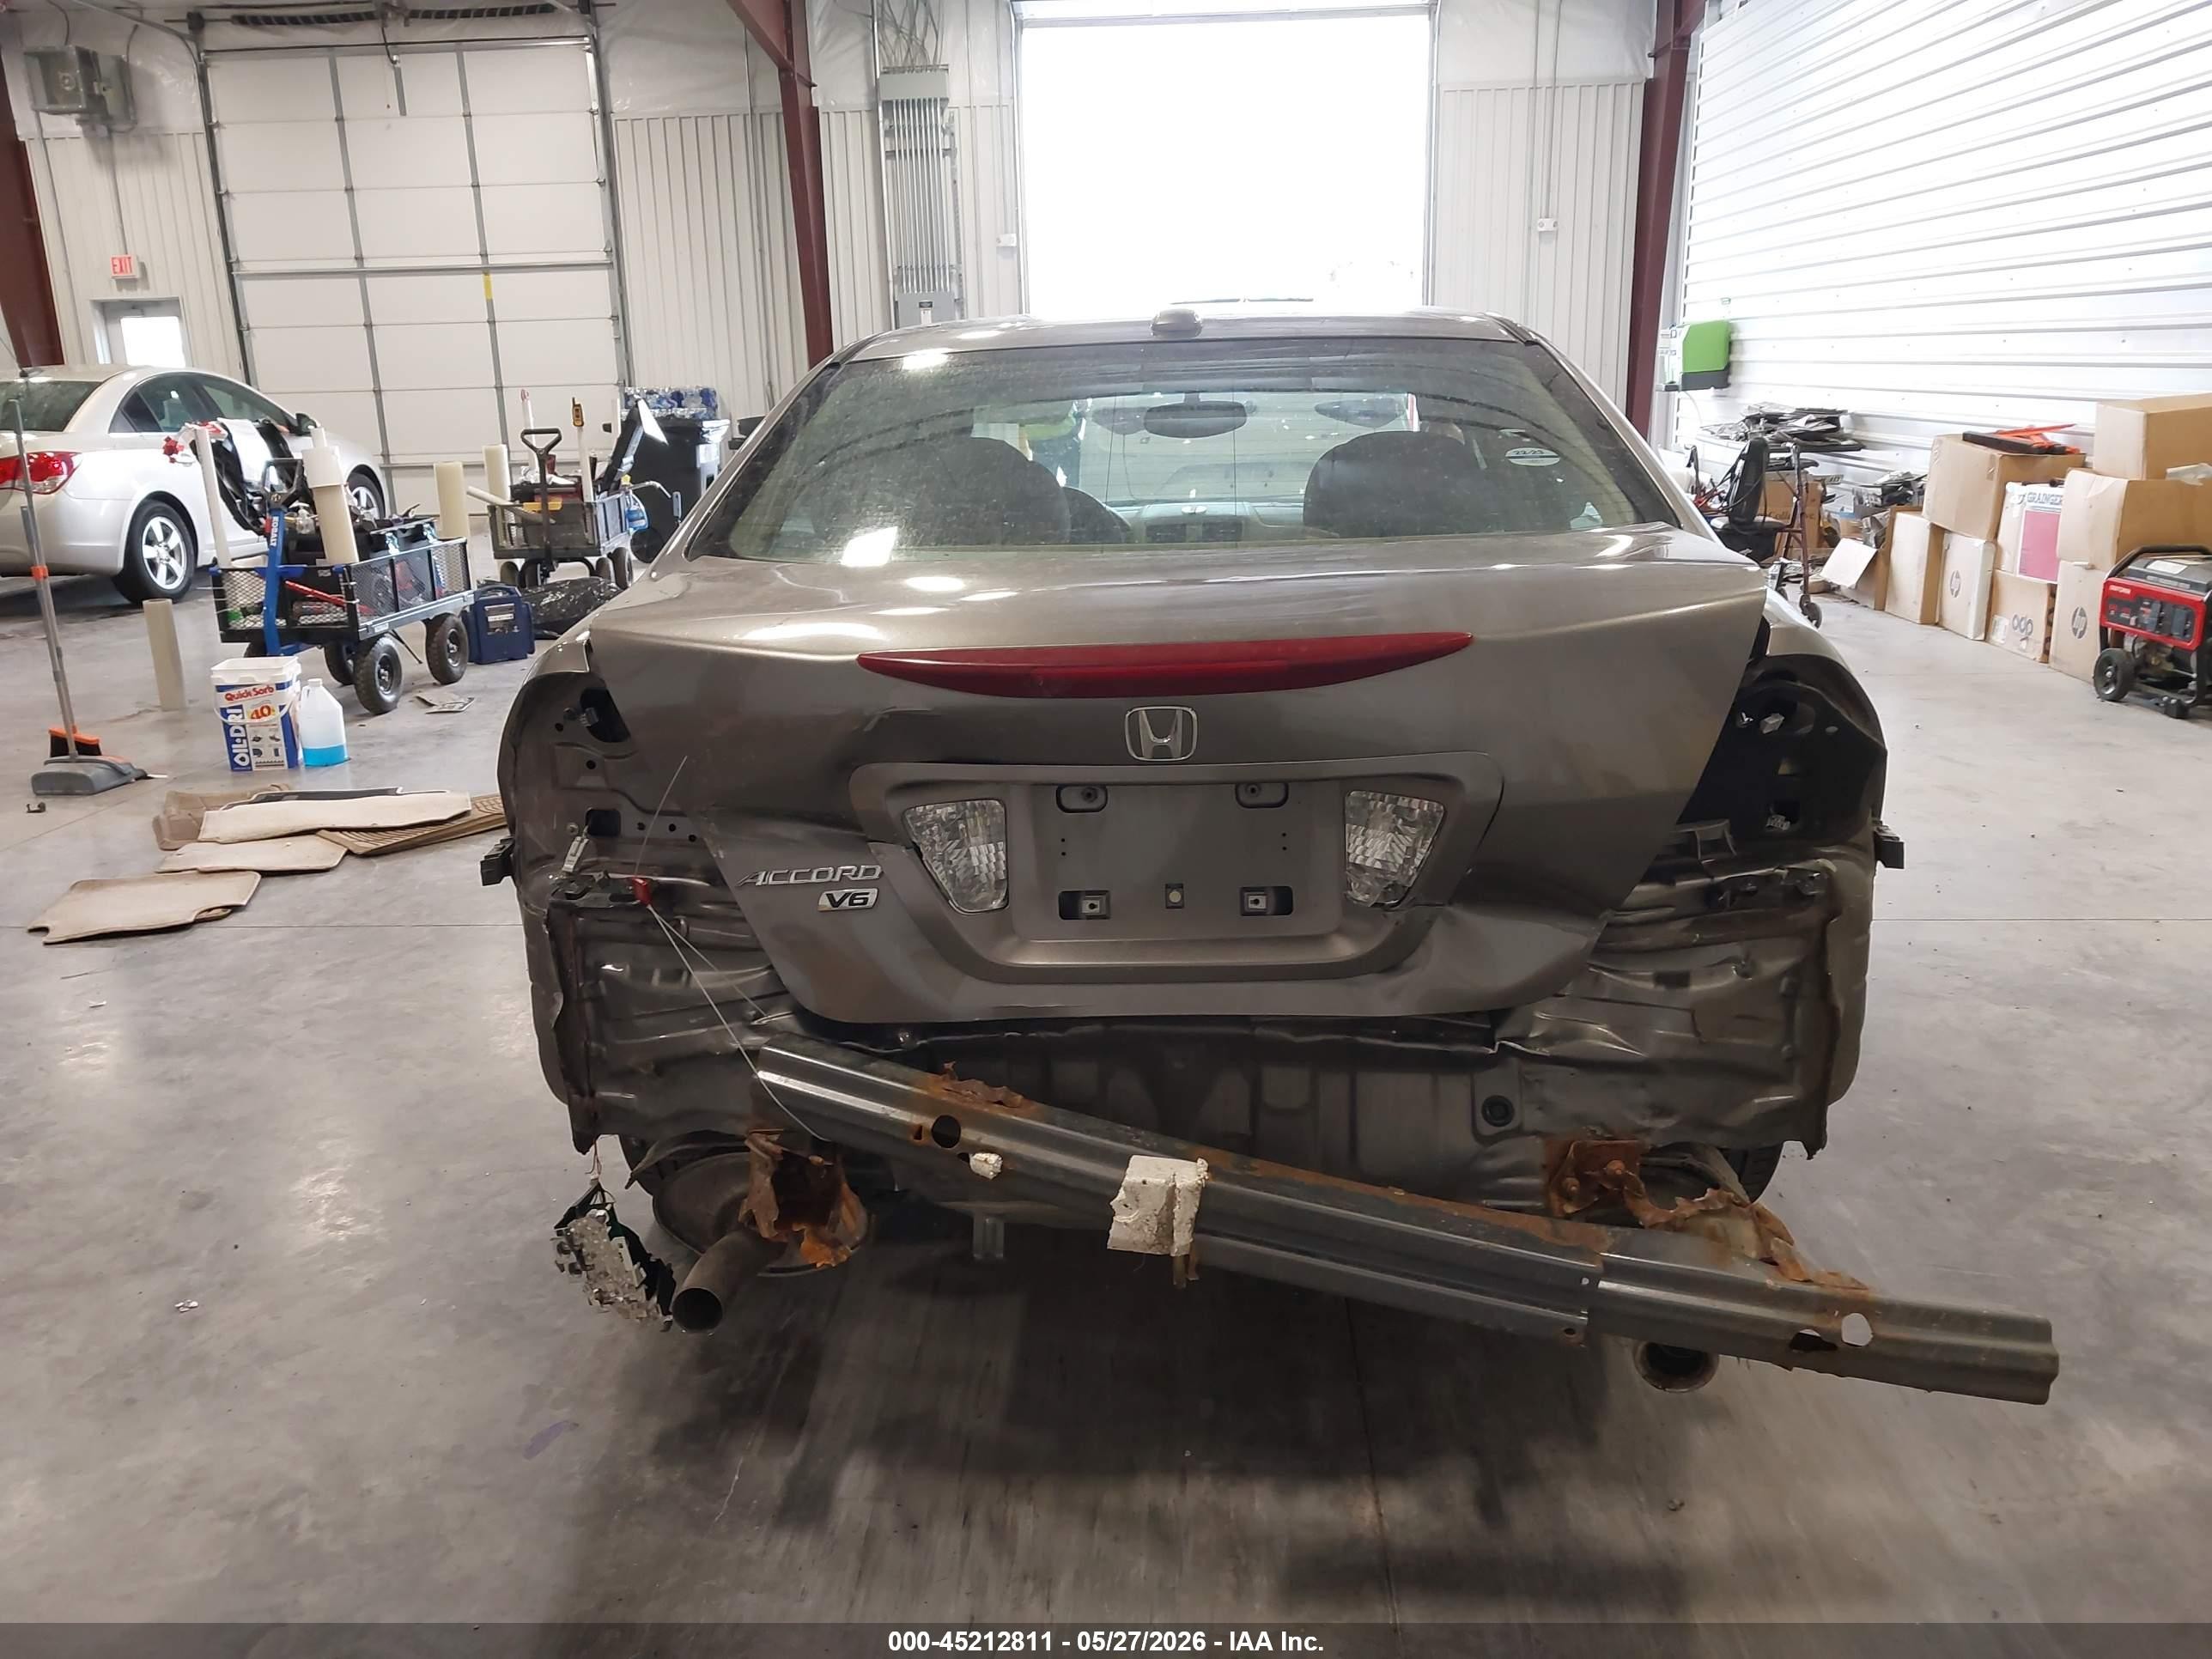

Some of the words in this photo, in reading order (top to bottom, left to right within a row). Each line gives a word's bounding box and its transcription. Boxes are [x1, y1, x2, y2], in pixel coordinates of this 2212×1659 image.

[112, 257, 132, 274] EXIT
[270, 516, 279, 546] KOBALT
[225, 689, 252, 702] Quick
[252, 685, 275, 696] Sorb
[738, 865, 883, 886] ACCORD
[826, 891, 870, 908] V6
